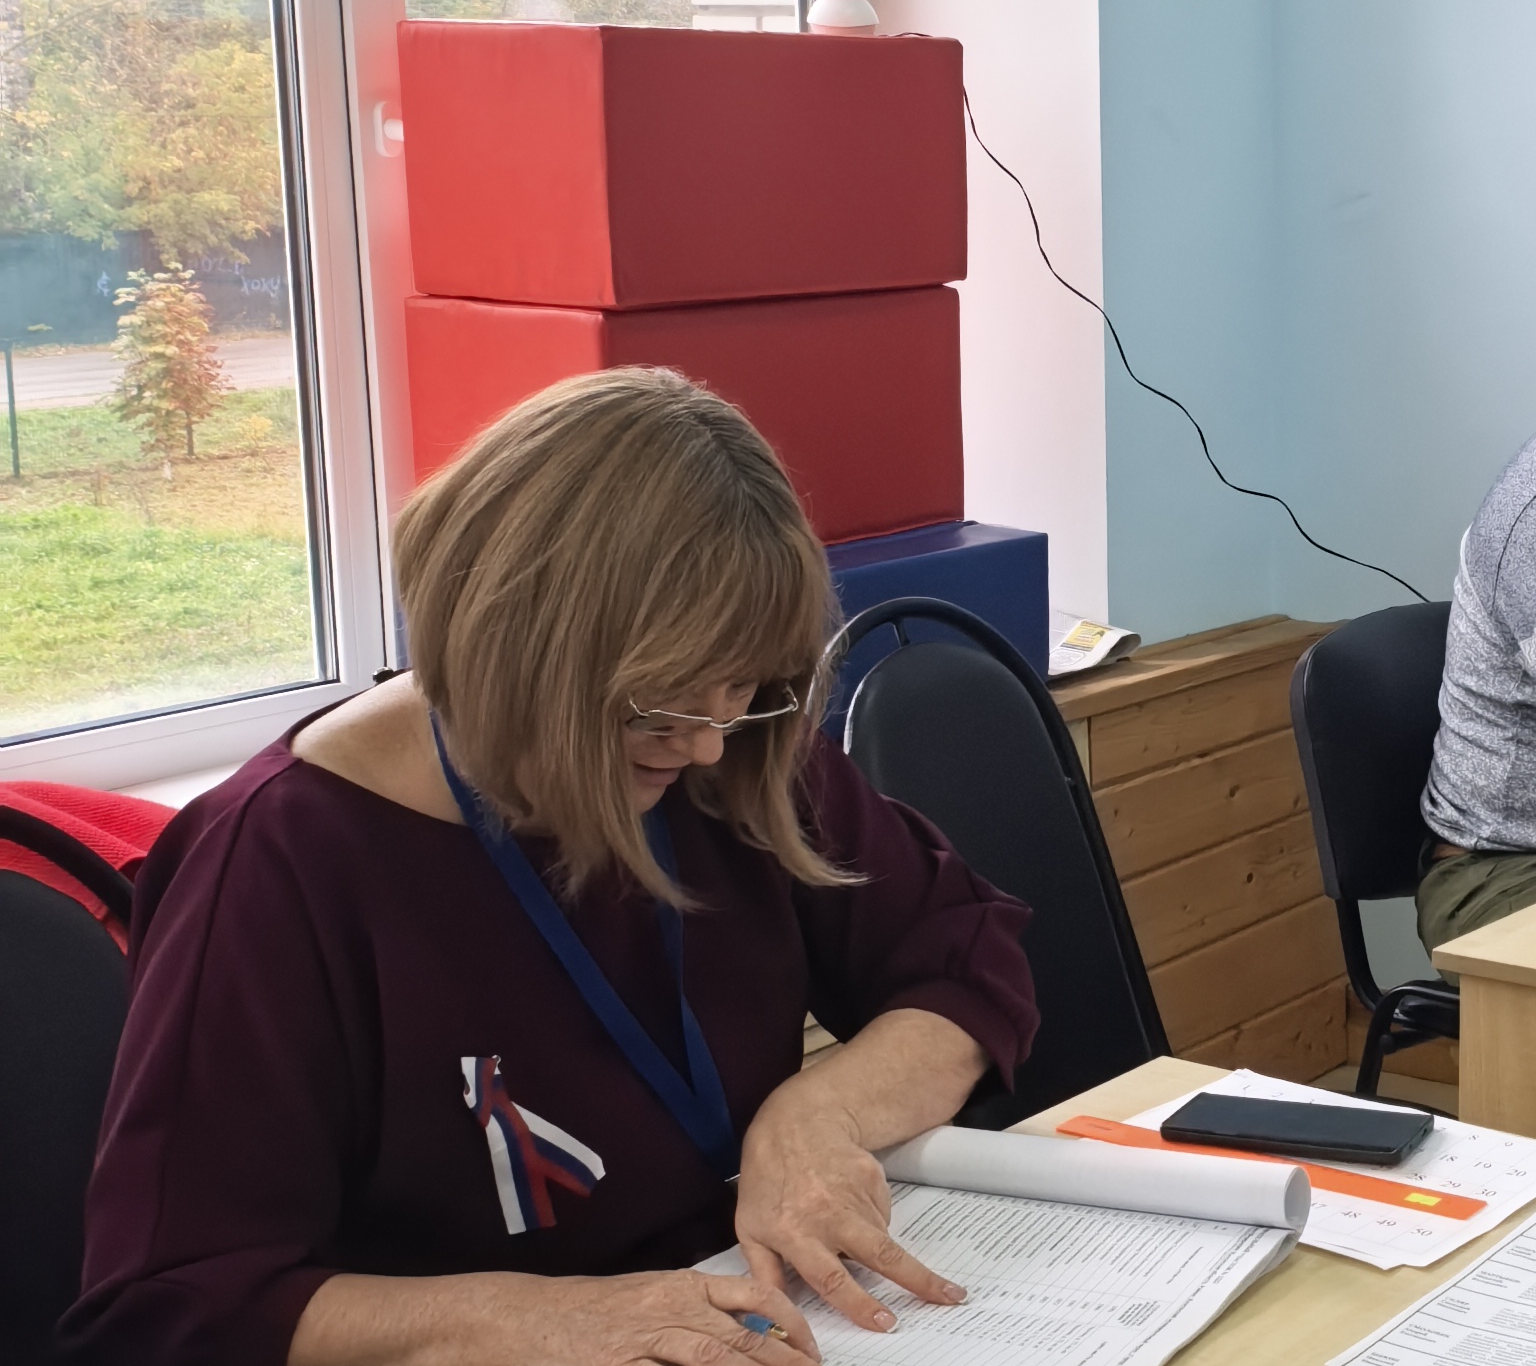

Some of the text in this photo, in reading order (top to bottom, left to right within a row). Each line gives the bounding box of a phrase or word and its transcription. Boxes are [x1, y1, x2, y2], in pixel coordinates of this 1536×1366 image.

[1439, 1153, 1528, 1179] 18 19 20
[1405, 1172, 1498, 1199] 28 29 30
[1339, 1209, 1362, 1221] 48
[1375, 1218, 1398, 1229] 49
[1410, 1227, 1433, 1238] 50
